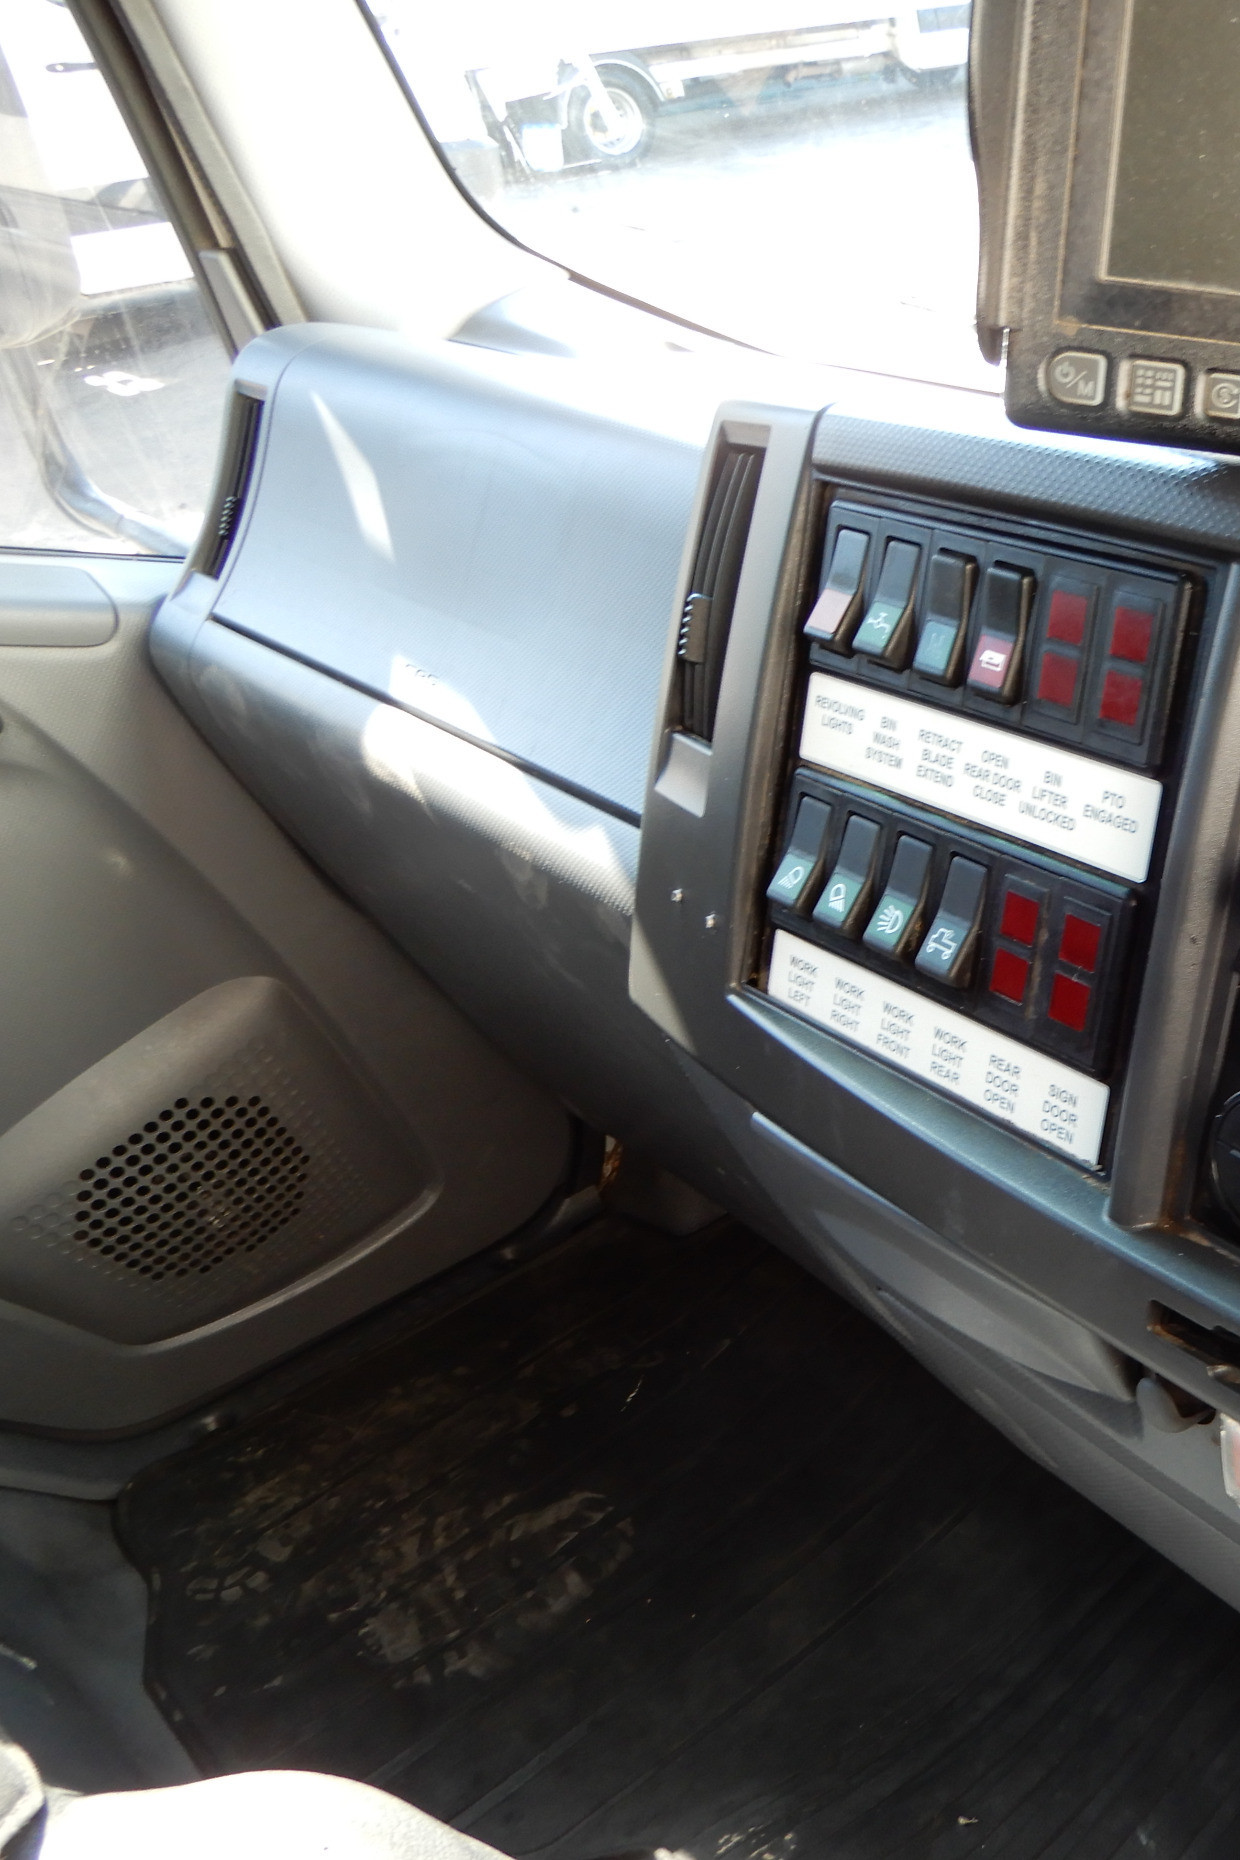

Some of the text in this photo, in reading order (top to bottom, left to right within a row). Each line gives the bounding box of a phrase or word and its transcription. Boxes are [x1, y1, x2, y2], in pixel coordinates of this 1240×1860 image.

[815, 695, 866, 721] REVOLVING
[821, 714, 853, 735] LIGHTS
[880, 716, 897, 730] BIN
[873, 731, 900, 751] WASH
[918, 729, 963, 753] RETRACT
[865, 747, 903, 770] SYSTEM
[921, 749, 954, 770] BLADE
[981, 750, 1010, 770] OPEN
[916, 765, 954, 788] EXTEND
[964, 763, 1022, 793] REAR DOOR
[1044, 771, 1062, 788] BIN
[973, 785, 1006, 807] CLOSE
[1032, 787, 1067, 810] LIFTER
[1102, 790, 1126, 809] PTO
[1018, 800, 1076, 832] UNLOCKED
[1083, 804, 1138, 834] ENGAGED
[790, 955, 817, 975] WORK
[788, 971, 816, 993] LIGHT
[835, 978, 865, 1001] WORK
[787, 987, 812, 1008] LEFT
[833, 995, 861, 1017] LIGHT
[830, 1010, 860, 1033] RIGHT
[882, 1002, 915, 1026] WORK
[880, 1018, 910, 1042] LIGHT
[933, 1026, 967, 1053] WORK
[876, 1033, 910, 1059] FRONT
[931, 1045, 964, 1070] LIGHT
[930, 1061, 961, 1085] REAR
[989, 1055, 1022, 1081] REAR
[985, 1072, 1019, 1098] DOOR
[1047, 1084, 1079, 1109] SIGN
[983, 1089, 1015, 1115] OPEN
[1042, 1100, 1079, 1126] DOOR
[1040, 1118, 1075, 1145] OPEN
